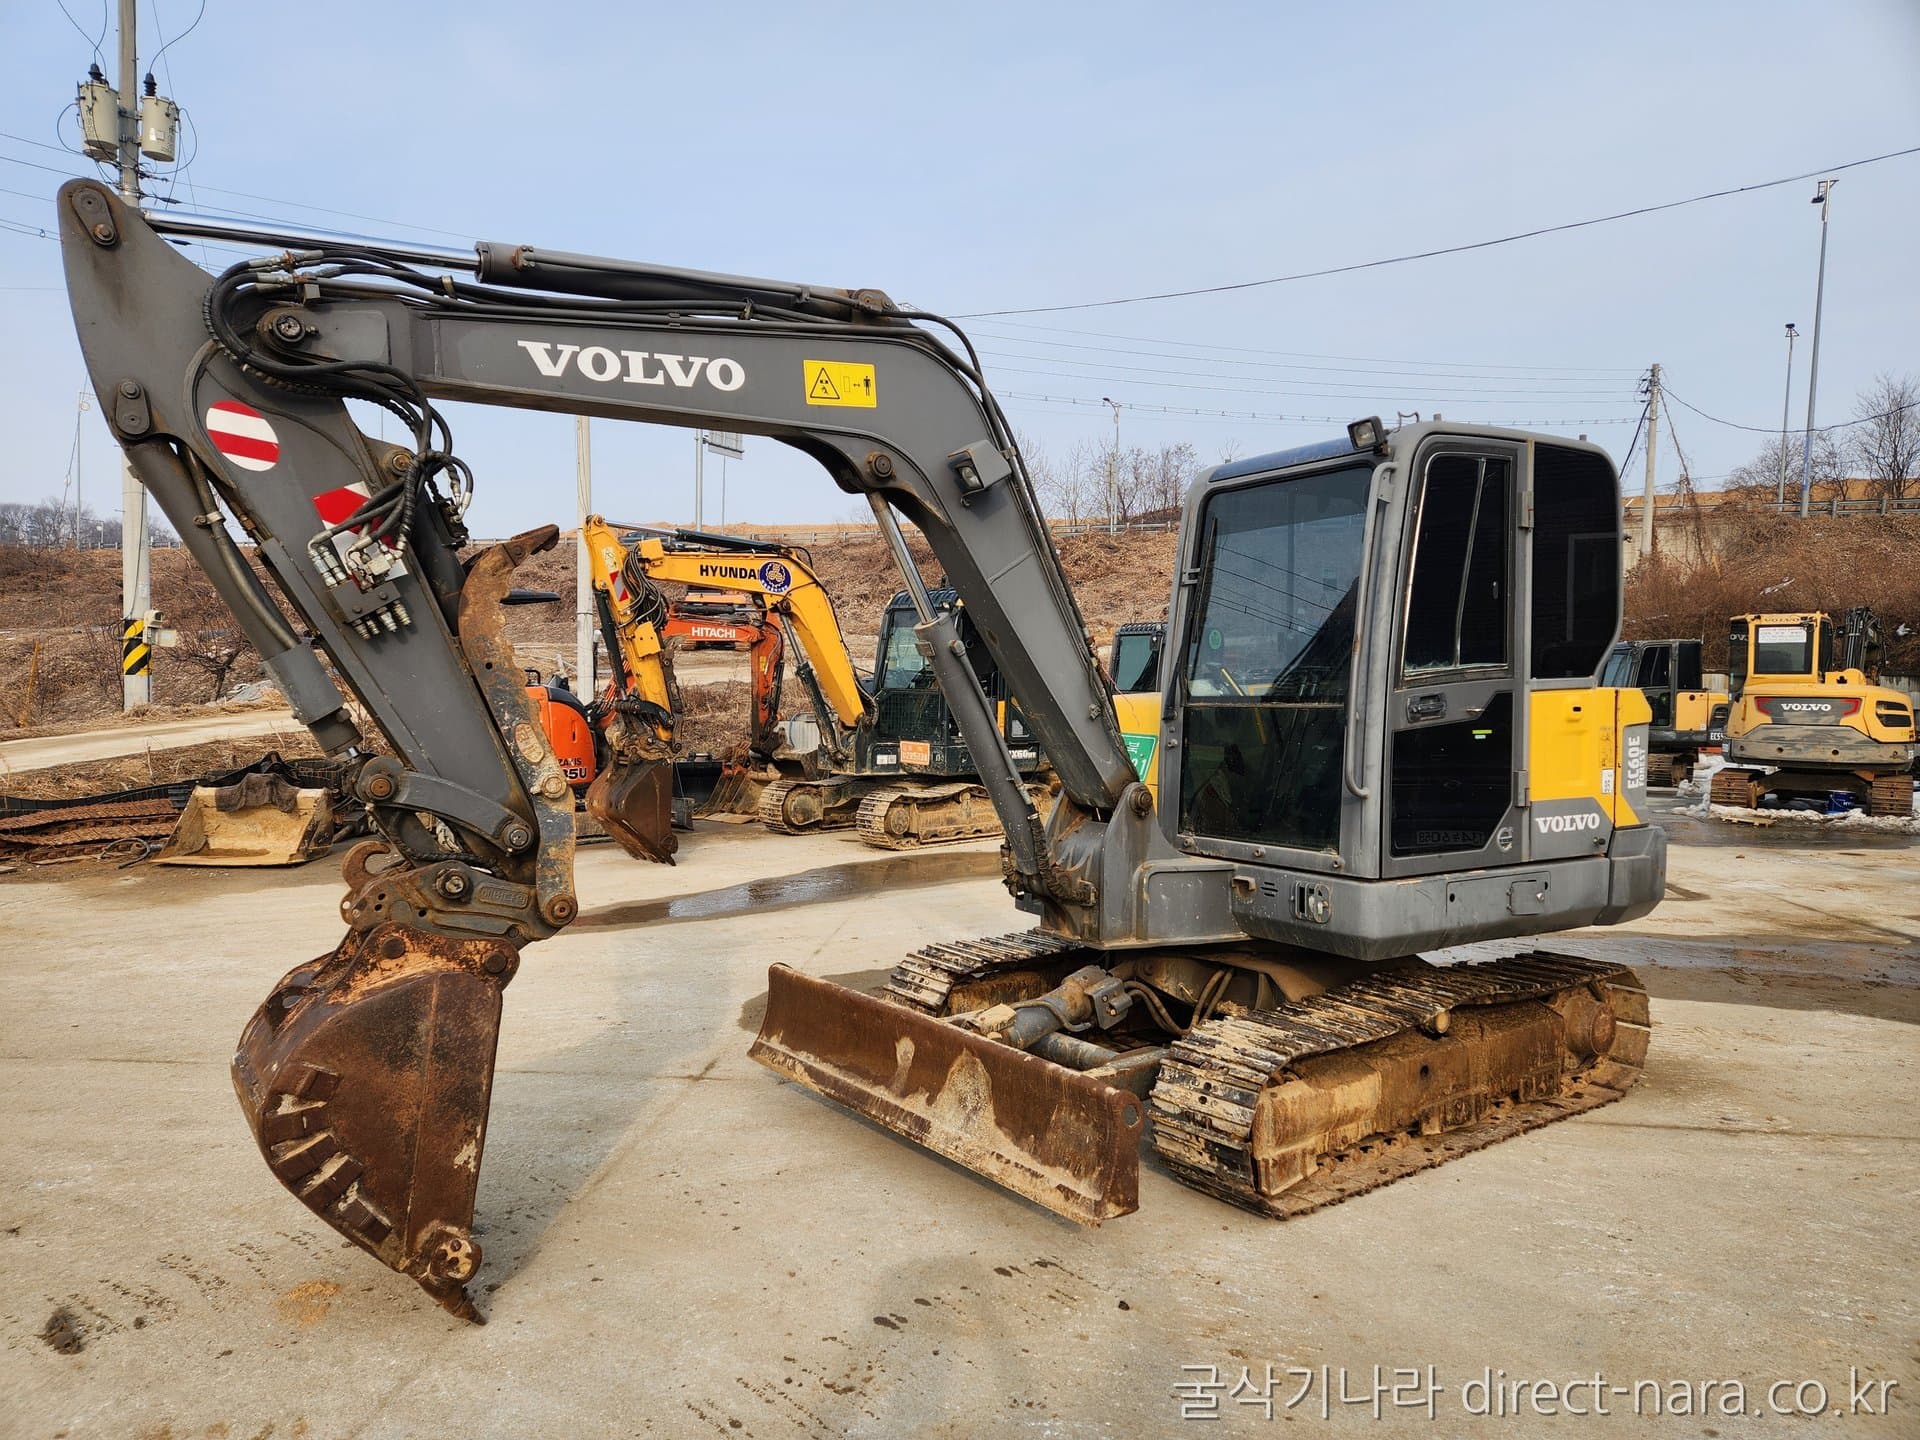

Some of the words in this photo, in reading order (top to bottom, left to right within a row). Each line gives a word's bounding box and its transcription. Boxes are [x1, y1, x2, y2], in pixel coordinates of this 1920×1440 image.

[518, 340, 746, 391] VOLVO
[691, 627, 736, 639] HITACHI
[1781, 703, 1832, 711] VOLVO
[1627, 735, 1641, 789] EC60E
[1535, 812, 1601, 834] VOLVO
